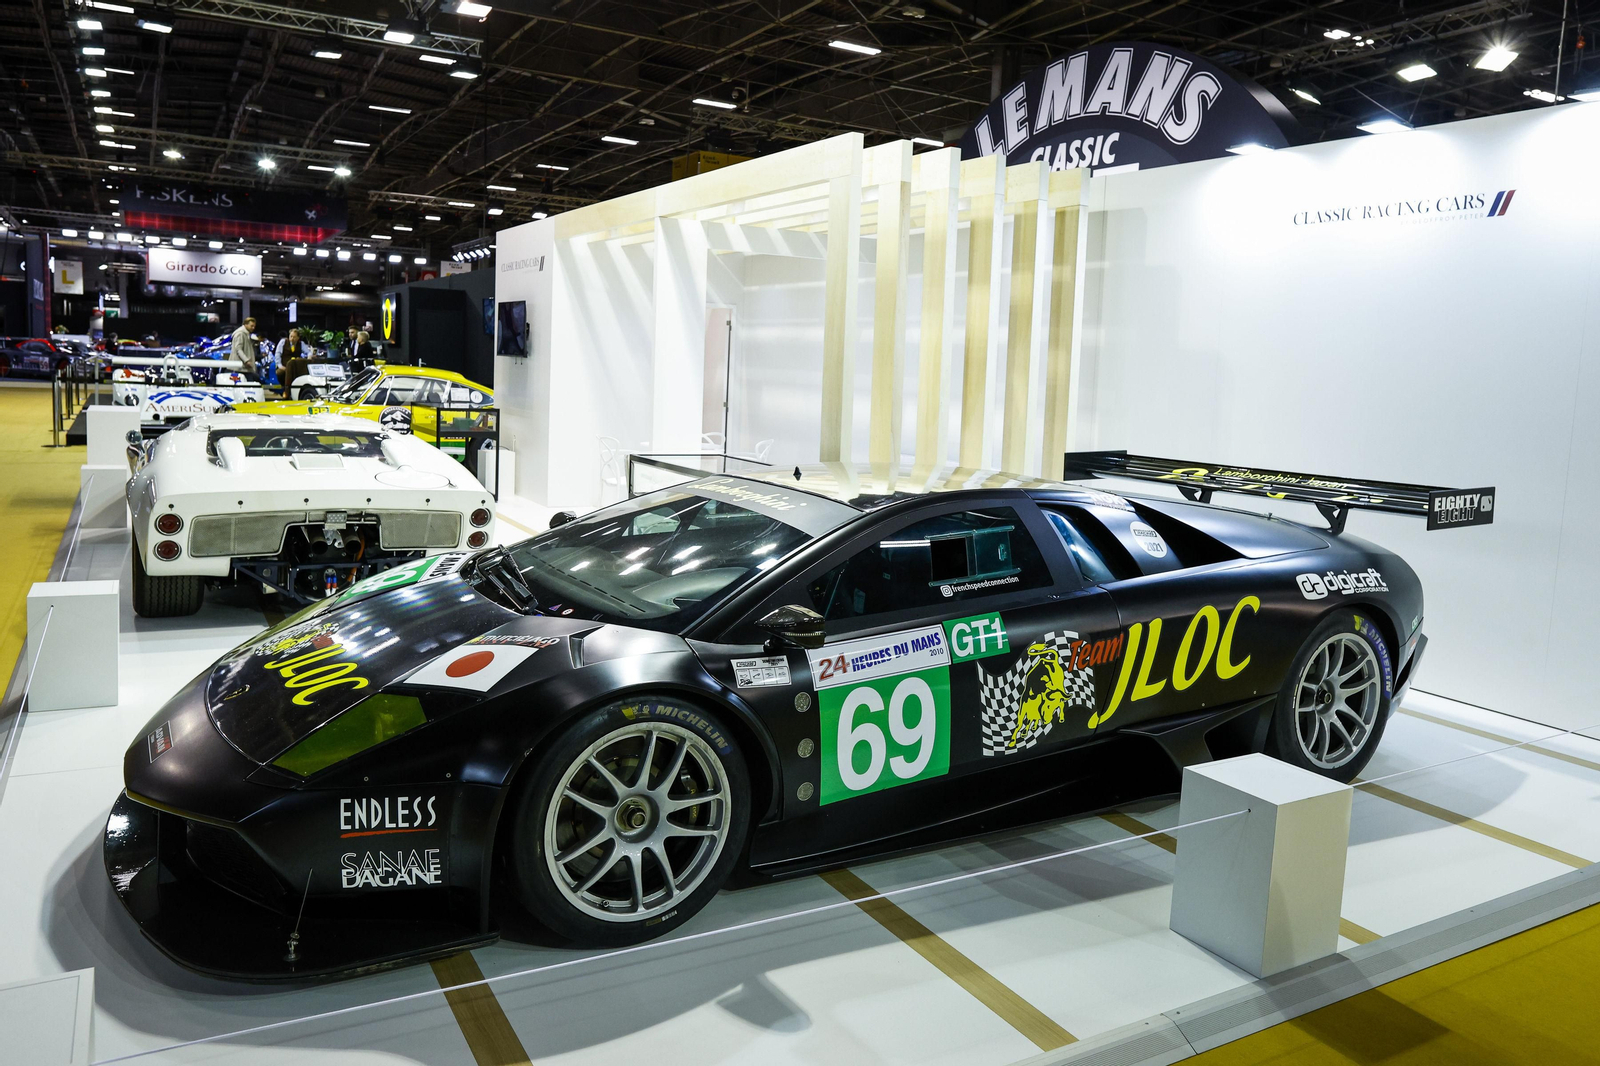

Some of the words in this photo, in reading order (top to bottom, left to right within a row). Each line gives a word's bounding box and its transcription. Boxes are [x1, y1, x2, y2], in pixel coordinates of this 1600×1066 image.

[975, 81, 1029, 156] LE
[1033, 48, 1222, 145] MANS
[1293, 207, 1357, 225] CLASSIC
[1362, 199, 1430, 219] RACING
[1436, 193, 1485, 212] CARS
[1412, 215, 1456, 225] GEOFFROY
[1459, 212, 1484, 221] PETER
[62, 270, 75, 285] L
[166, 260, 217, 274] Girardo
[218, 265, 229, 275] &
[230, 267, 249, 277] Co.
[1213, 467, 1302, 485] Lamborghini
[1301, 477, 1348, 490] Japan
[1434, 493, 1481, 512] EIGHTY
[1437, 505, 1477, 524] EIGHT
[1144, 541, 1164, 552] 2021
[951, 575, 1020, 593] frenchspeedconnection
[1323, 568, 1387, 595] digicraft
[1354, 586, 1390, 594] CORPORATION
[951, 617, 1005, 658] GT1
[818, 652, 850, 682] 24
[851, 647, 892, 673] HEURES
[893, 642, 910, 658] DU
[910, 632, 942, 654] MANS
[929, 648, 944, 658] 2010
[1067, 633, 1124, 673] Team
[1087, 595, 1261, 729] JLOC
[1368, 629, 1391, 692] MICHELIN
[263, 643, 369, 706] JLOC
[655, 705, 729, 749] MICHELIN
[837, 677, 937, 791] 69
[340, 796, 437, 830] ENDLESS
[340, 849, 441, 878] SANAE
[341, 865, 442, 889] DAGANE
